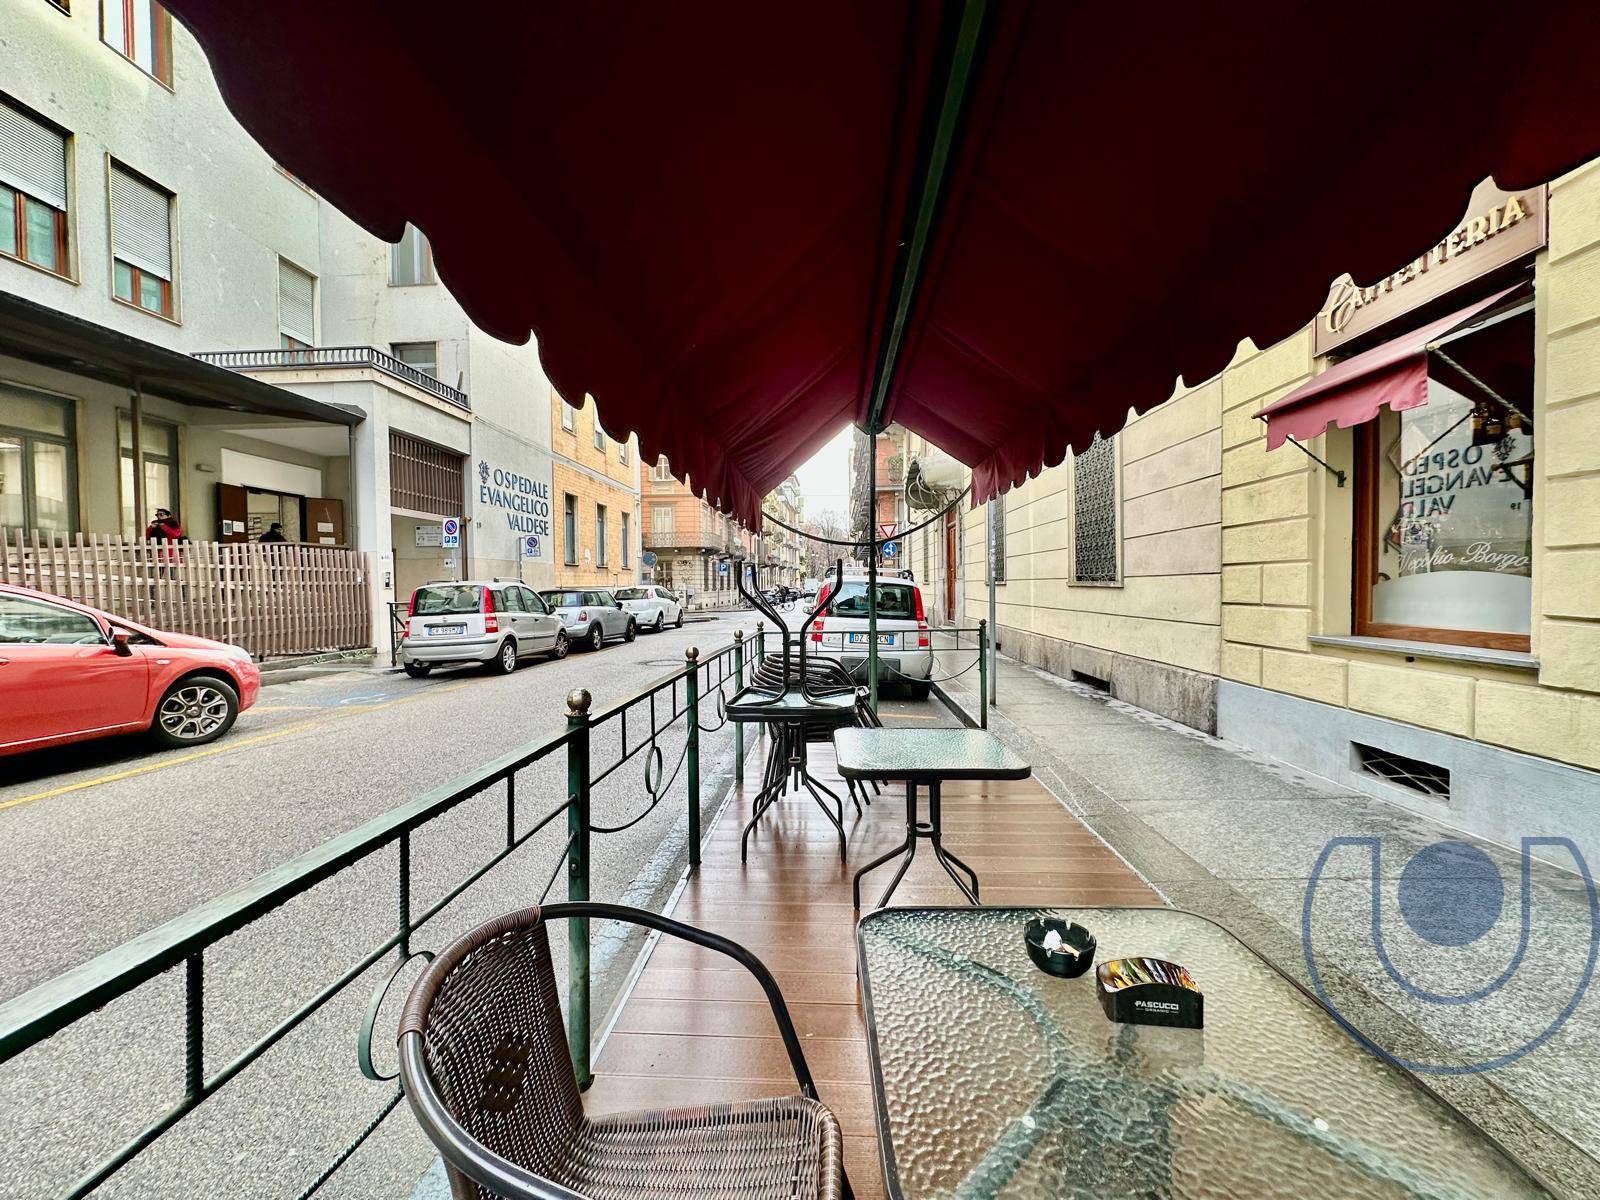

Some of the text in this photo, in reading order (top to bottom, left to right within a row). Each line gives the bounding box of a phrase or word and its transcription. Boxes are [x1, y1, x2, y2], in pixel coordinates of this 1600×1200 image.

[494, 468, 548, 499] OSPEDALE
[480, 485, 549, 517] EVANGELICO
[507, 513, 549, 536] VALDESE
[1461, 541, 1529, 571] Borgo
[1134, 1000, 1179, 1010] PASCUCCI
